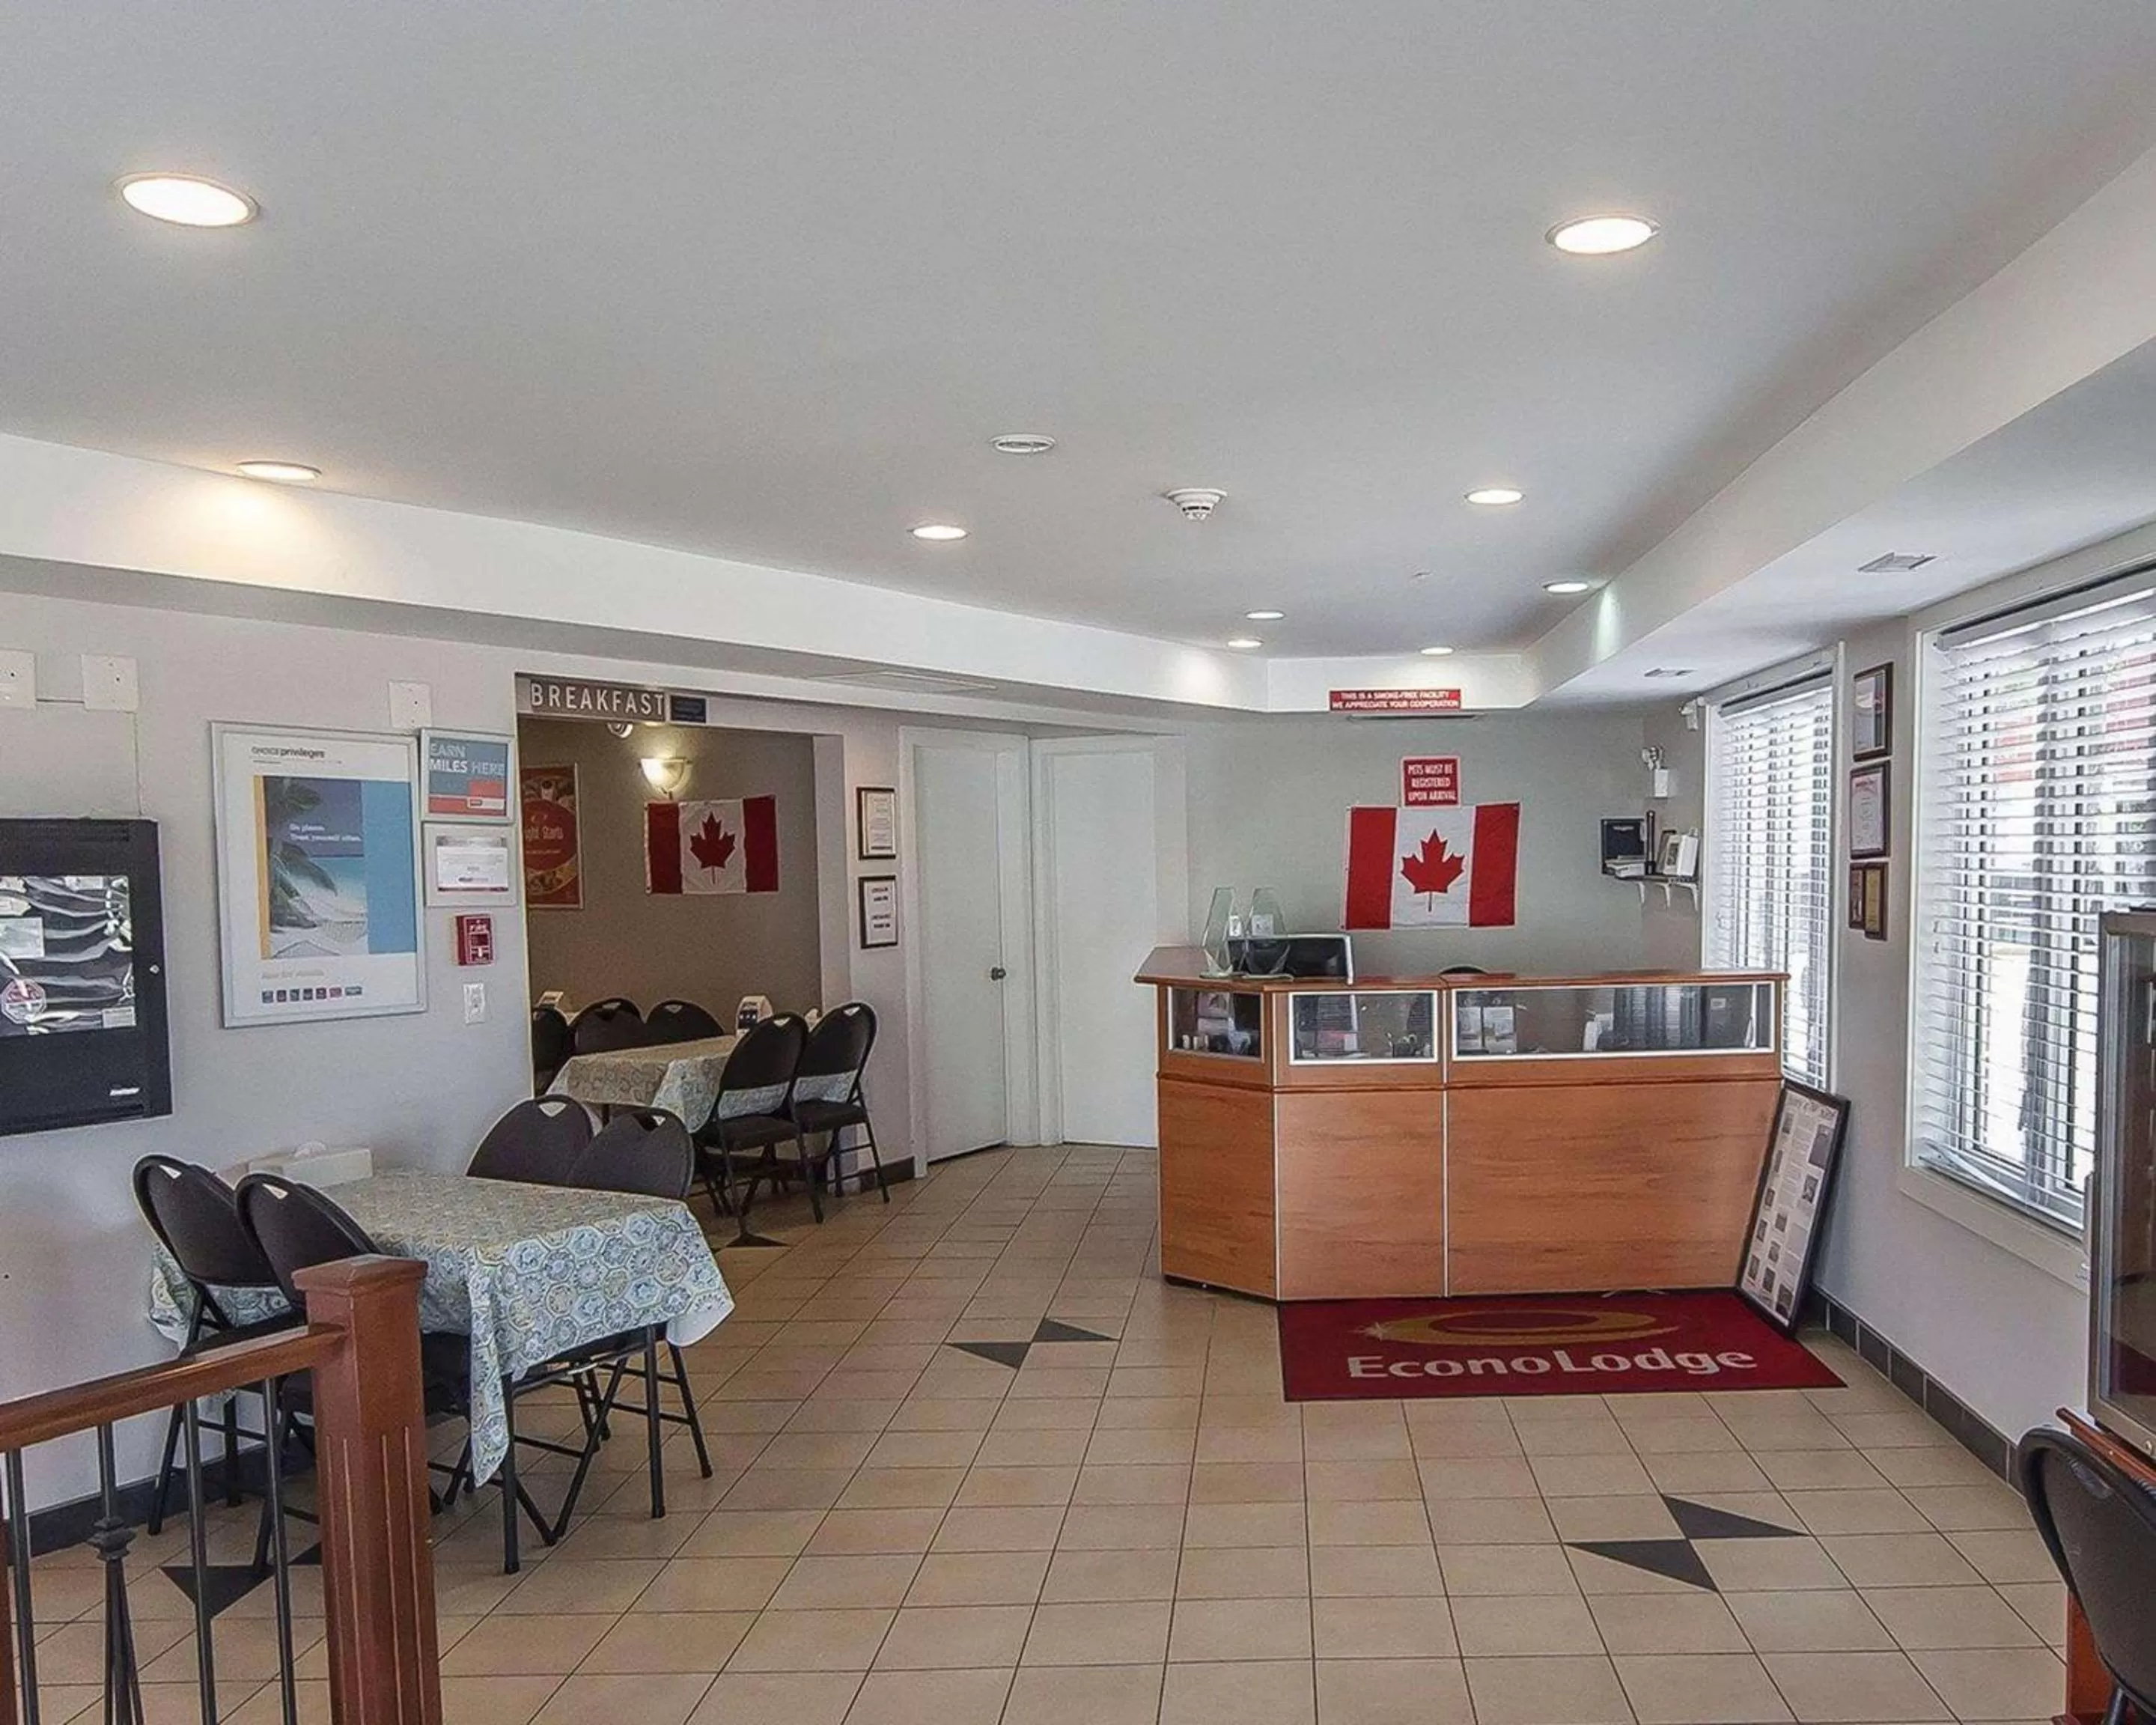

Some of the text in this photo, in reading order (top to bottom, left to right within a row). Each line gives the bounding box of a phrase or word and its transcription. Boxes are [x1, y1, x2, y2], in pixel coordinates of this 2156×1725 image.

[531, 683, 665, 716] BREAKFAST
[429, 758, 505, 776] MILES HERE
[1348, 1348, 1758, 1378] EconoLodge
